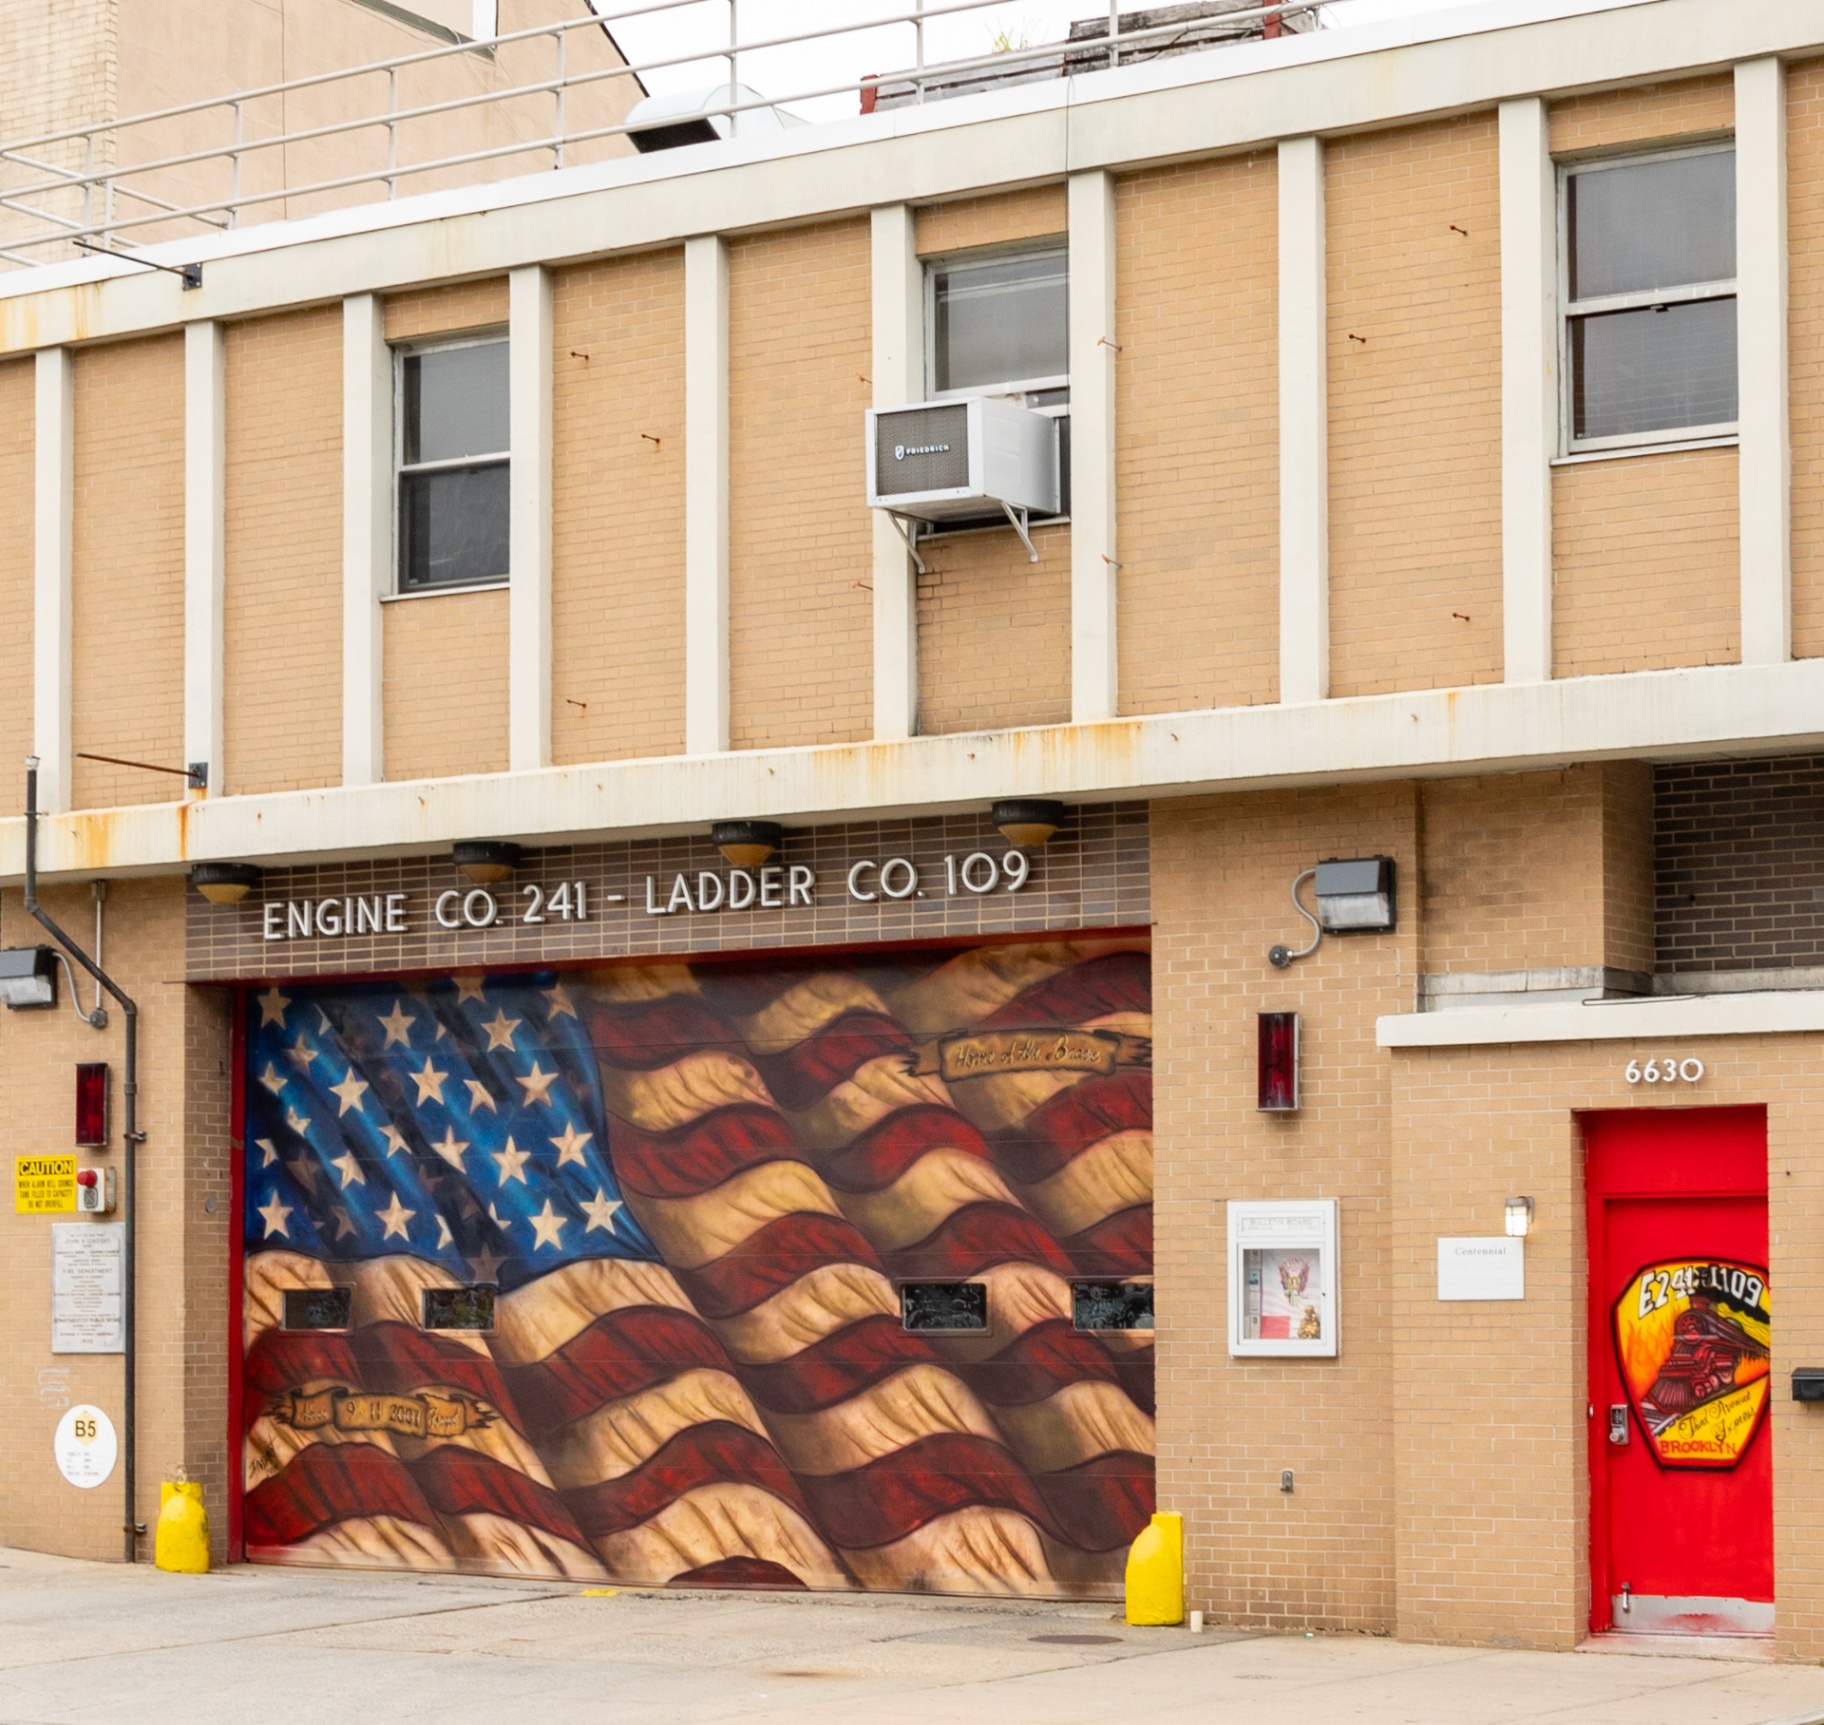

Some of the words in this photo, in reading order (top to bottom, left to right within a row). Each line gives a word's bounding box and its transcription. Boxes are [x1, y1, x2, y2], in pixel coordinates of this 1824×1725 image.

[905, 444, 949, 455] FRIEDRICH
[263, 893, 408, 940] ENGINE
[435, 888, 504, 929] CO.
[522, 880, 588, 924] 241
[645, 864, 816, 915] LADDER
[847, 857, 926, 901] CO.
[943, 848, 1030, 895] 109
[1625, 1057, 1705, 1084] 6630
[20, 1160, 72, 1176] CAUTION
[1250, 1218, 1284, 1226] BULLETIN
[1286, 1218, 1313, 1226] BOARD
[1454, 1246, 1507, 1256] Centennial
[75, 1420, 96, 1438] B5
[1660, 1440, 1737, 1455] BROOKLYN
